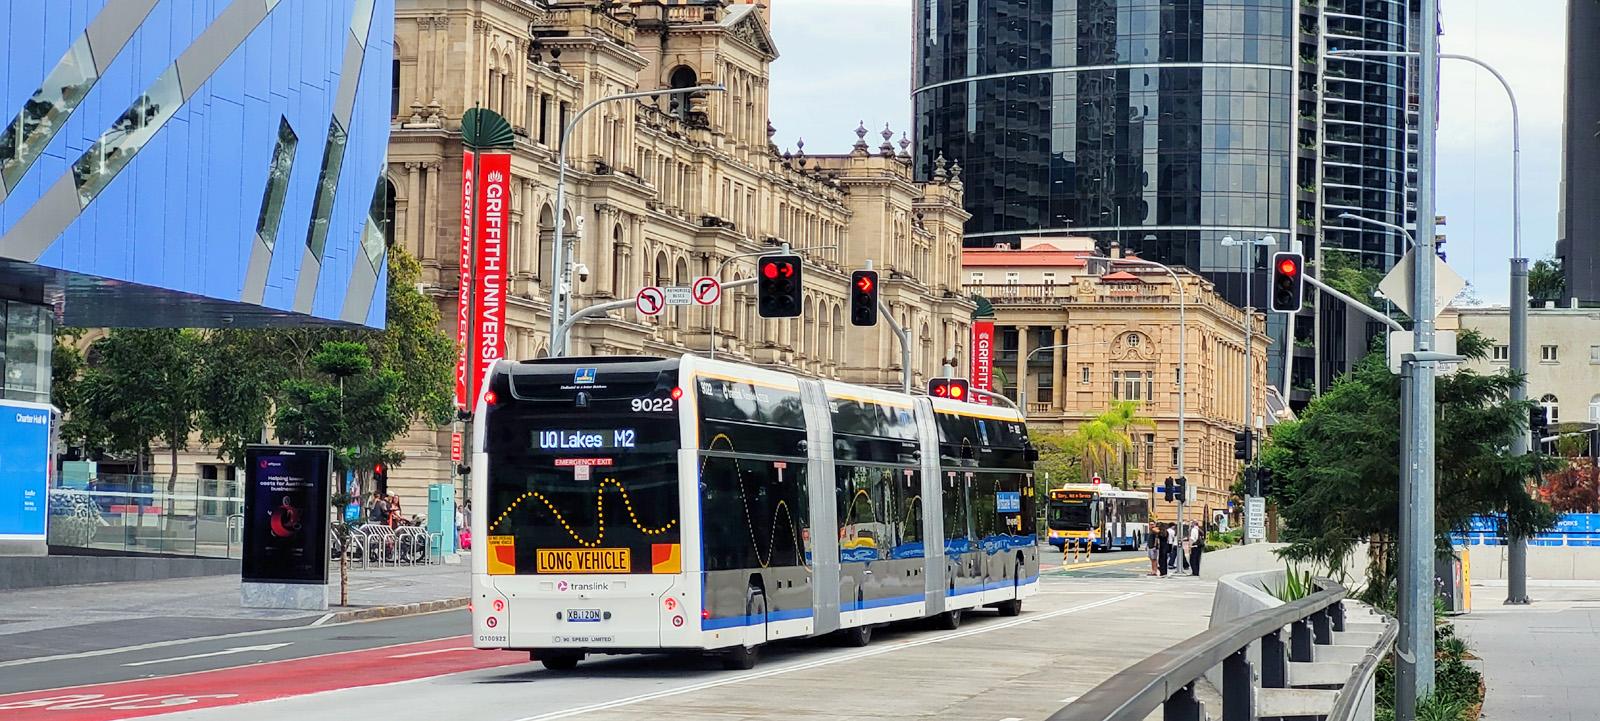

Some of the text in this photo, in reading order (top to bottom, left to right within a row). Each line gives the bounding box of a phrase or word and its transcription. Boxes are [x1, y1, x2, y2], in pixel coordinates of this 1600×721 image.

[463, 181, 472, 268] GRIFFITH
[482, 184, 503, 383] GRIFFITH UNIVERSI
[978, 340, 989, 392] GRIFFITH
[631, 398, 673, 412] 9022
[16, 413, 42, 424] Charter Hall
[540, 430, 635, 448] UQ Lakes M2
[540, 551, 627, 570] LONG VEHICLE
[570, 581, 609, 591] translink
[0, 694, 239, 710] BUS
